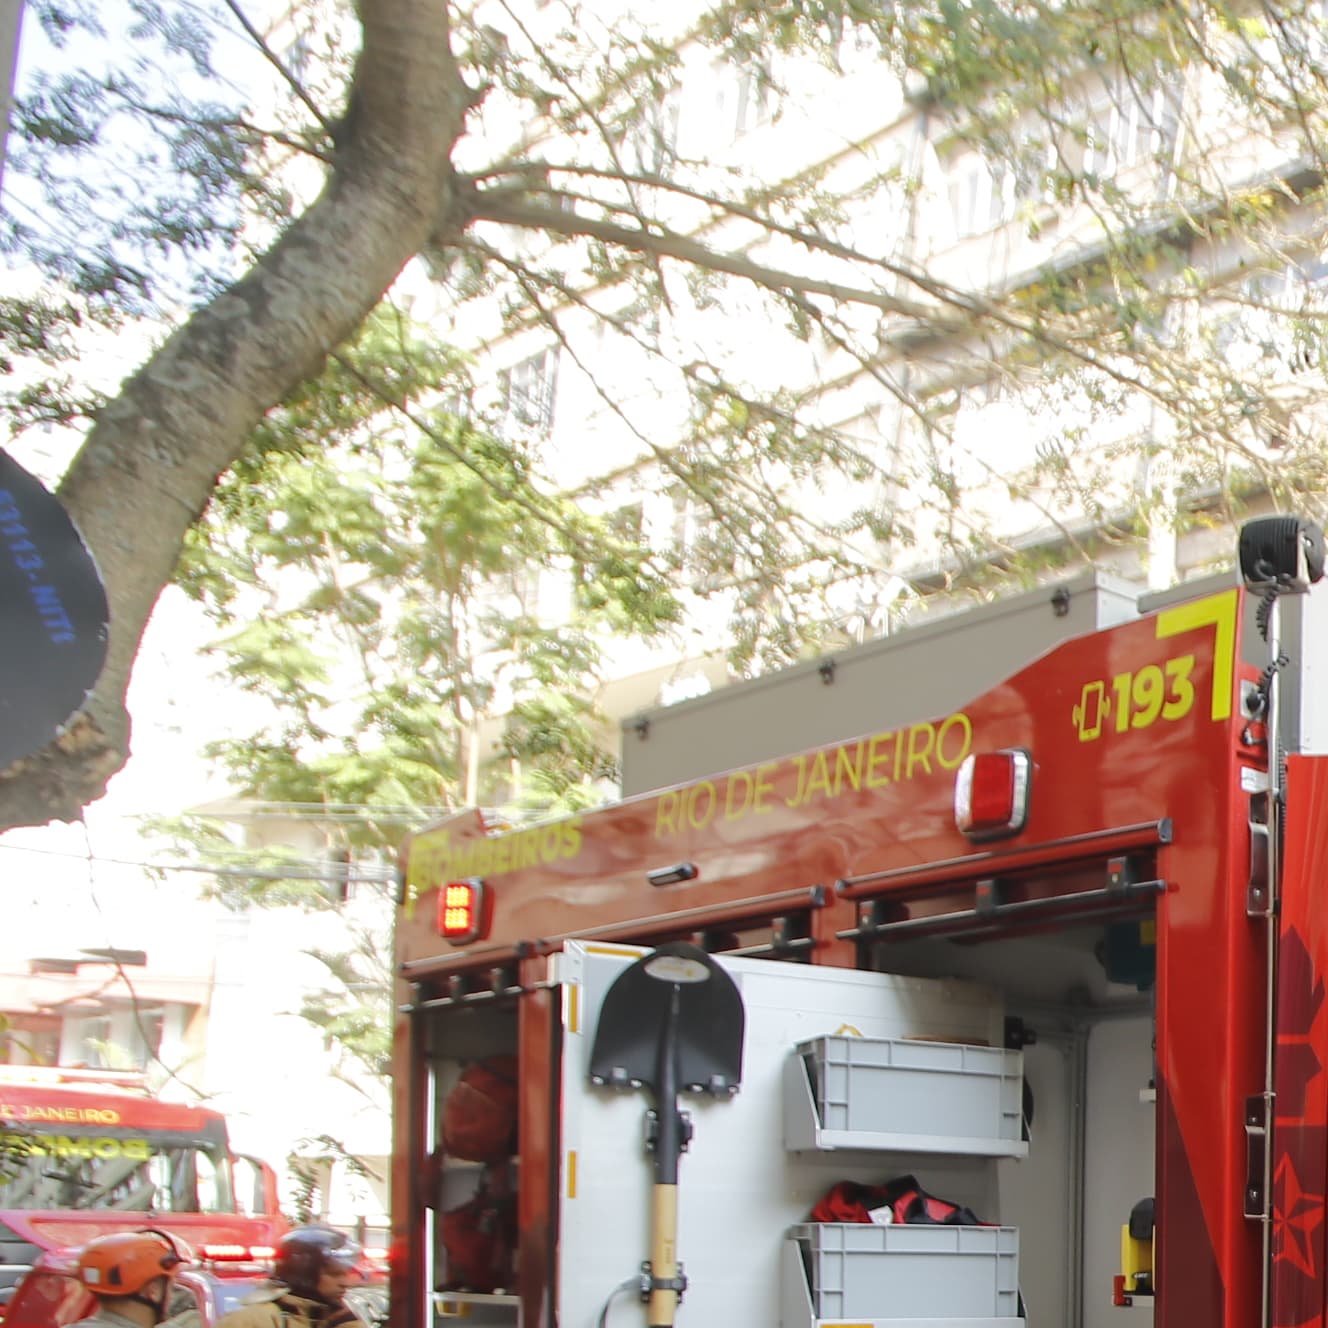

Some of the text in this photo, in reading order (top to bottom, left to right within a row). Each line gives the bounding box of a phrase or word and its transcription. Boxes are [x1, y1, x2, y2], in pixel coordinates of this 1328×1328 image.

[1113, 654, 1196, 733] 193
[412, 712, 973, 893] BOMBEIROS RIO DE JANEIRO
[21, 1104, 121, 1125] JANEIRO
